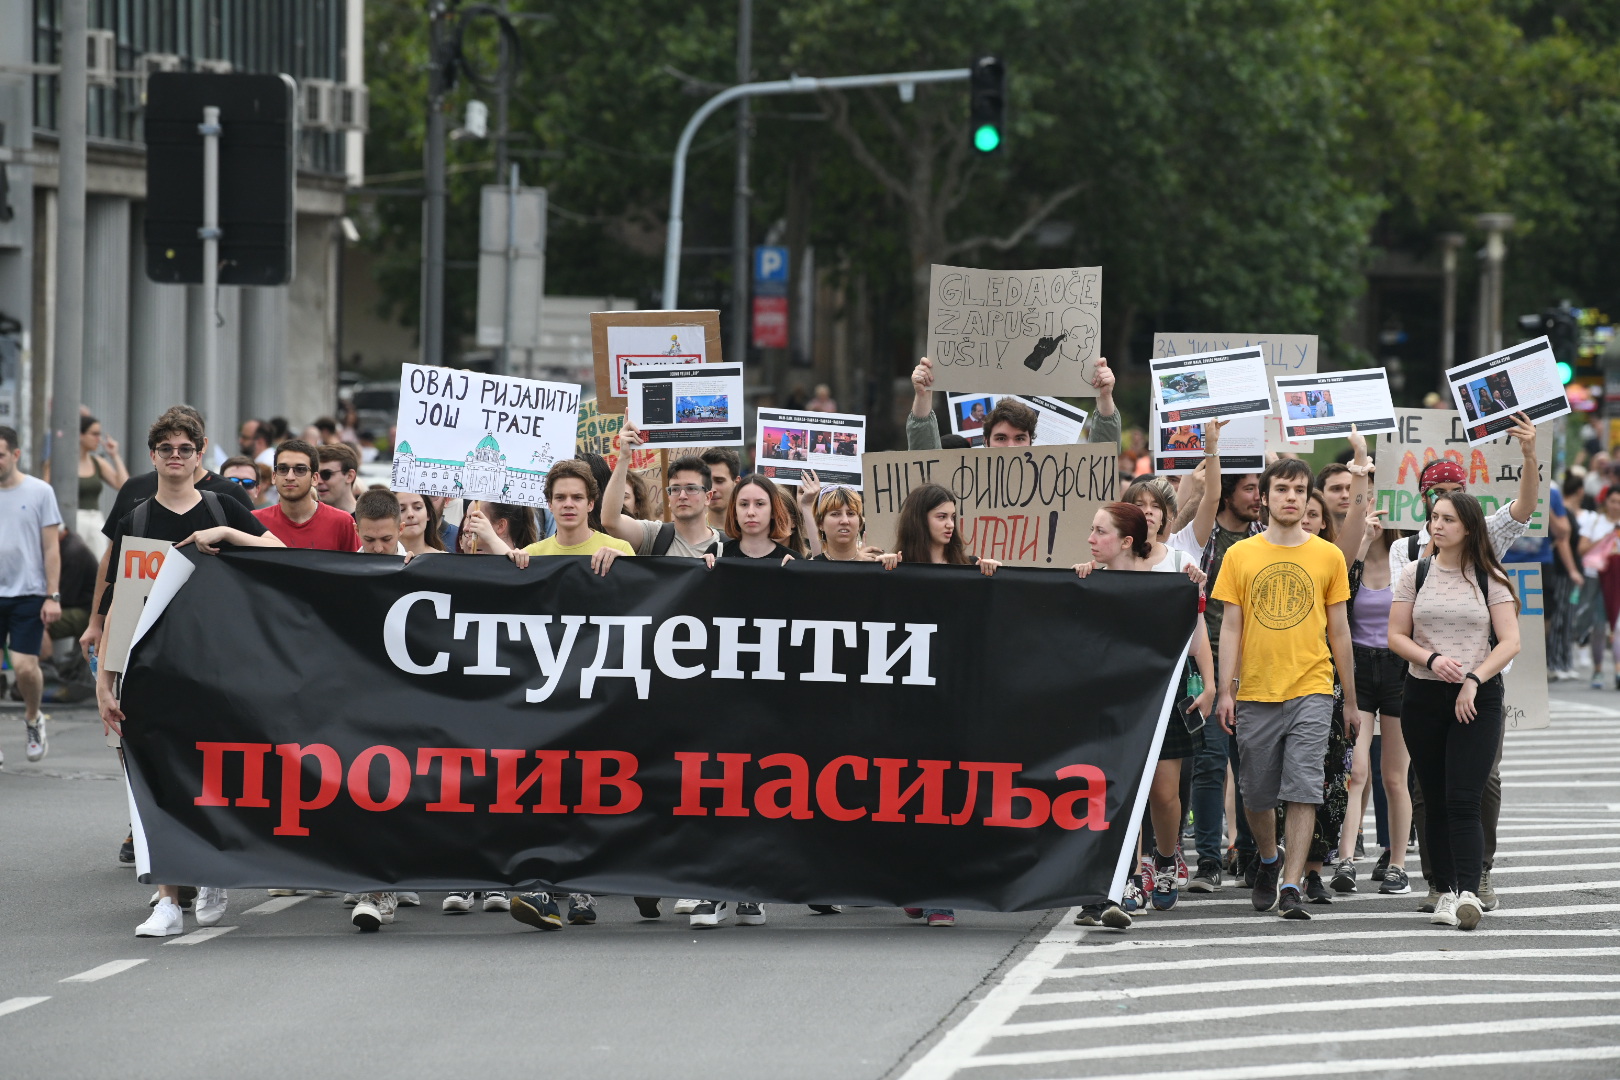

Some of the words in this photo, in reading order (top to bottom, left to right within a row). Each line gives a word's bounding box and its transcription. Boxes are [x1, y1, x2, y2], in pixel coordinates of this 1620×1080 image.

[934, 308, 1054, 339] ZAPUŠI
[936, 337, 1010, 369] UŠI!
[1157, 340, 1177, 359] ЗА
[1245, 340, 1308, 371] ЕЦУ
[410, 368, 469, 401] ОВАЈ
[415, 400, 460, 429] ЈОШ
[481, 408, 545, 438] ТРАЈЕ
[951, 452, 1116, 516] ФИЛОЗОФСКИ
[124, 550, 165, 580] ПО
[384, 590, 938, 704] Студенти
[194, 741, 643, 837] против
[673, 751, 1110, 832] насиља
